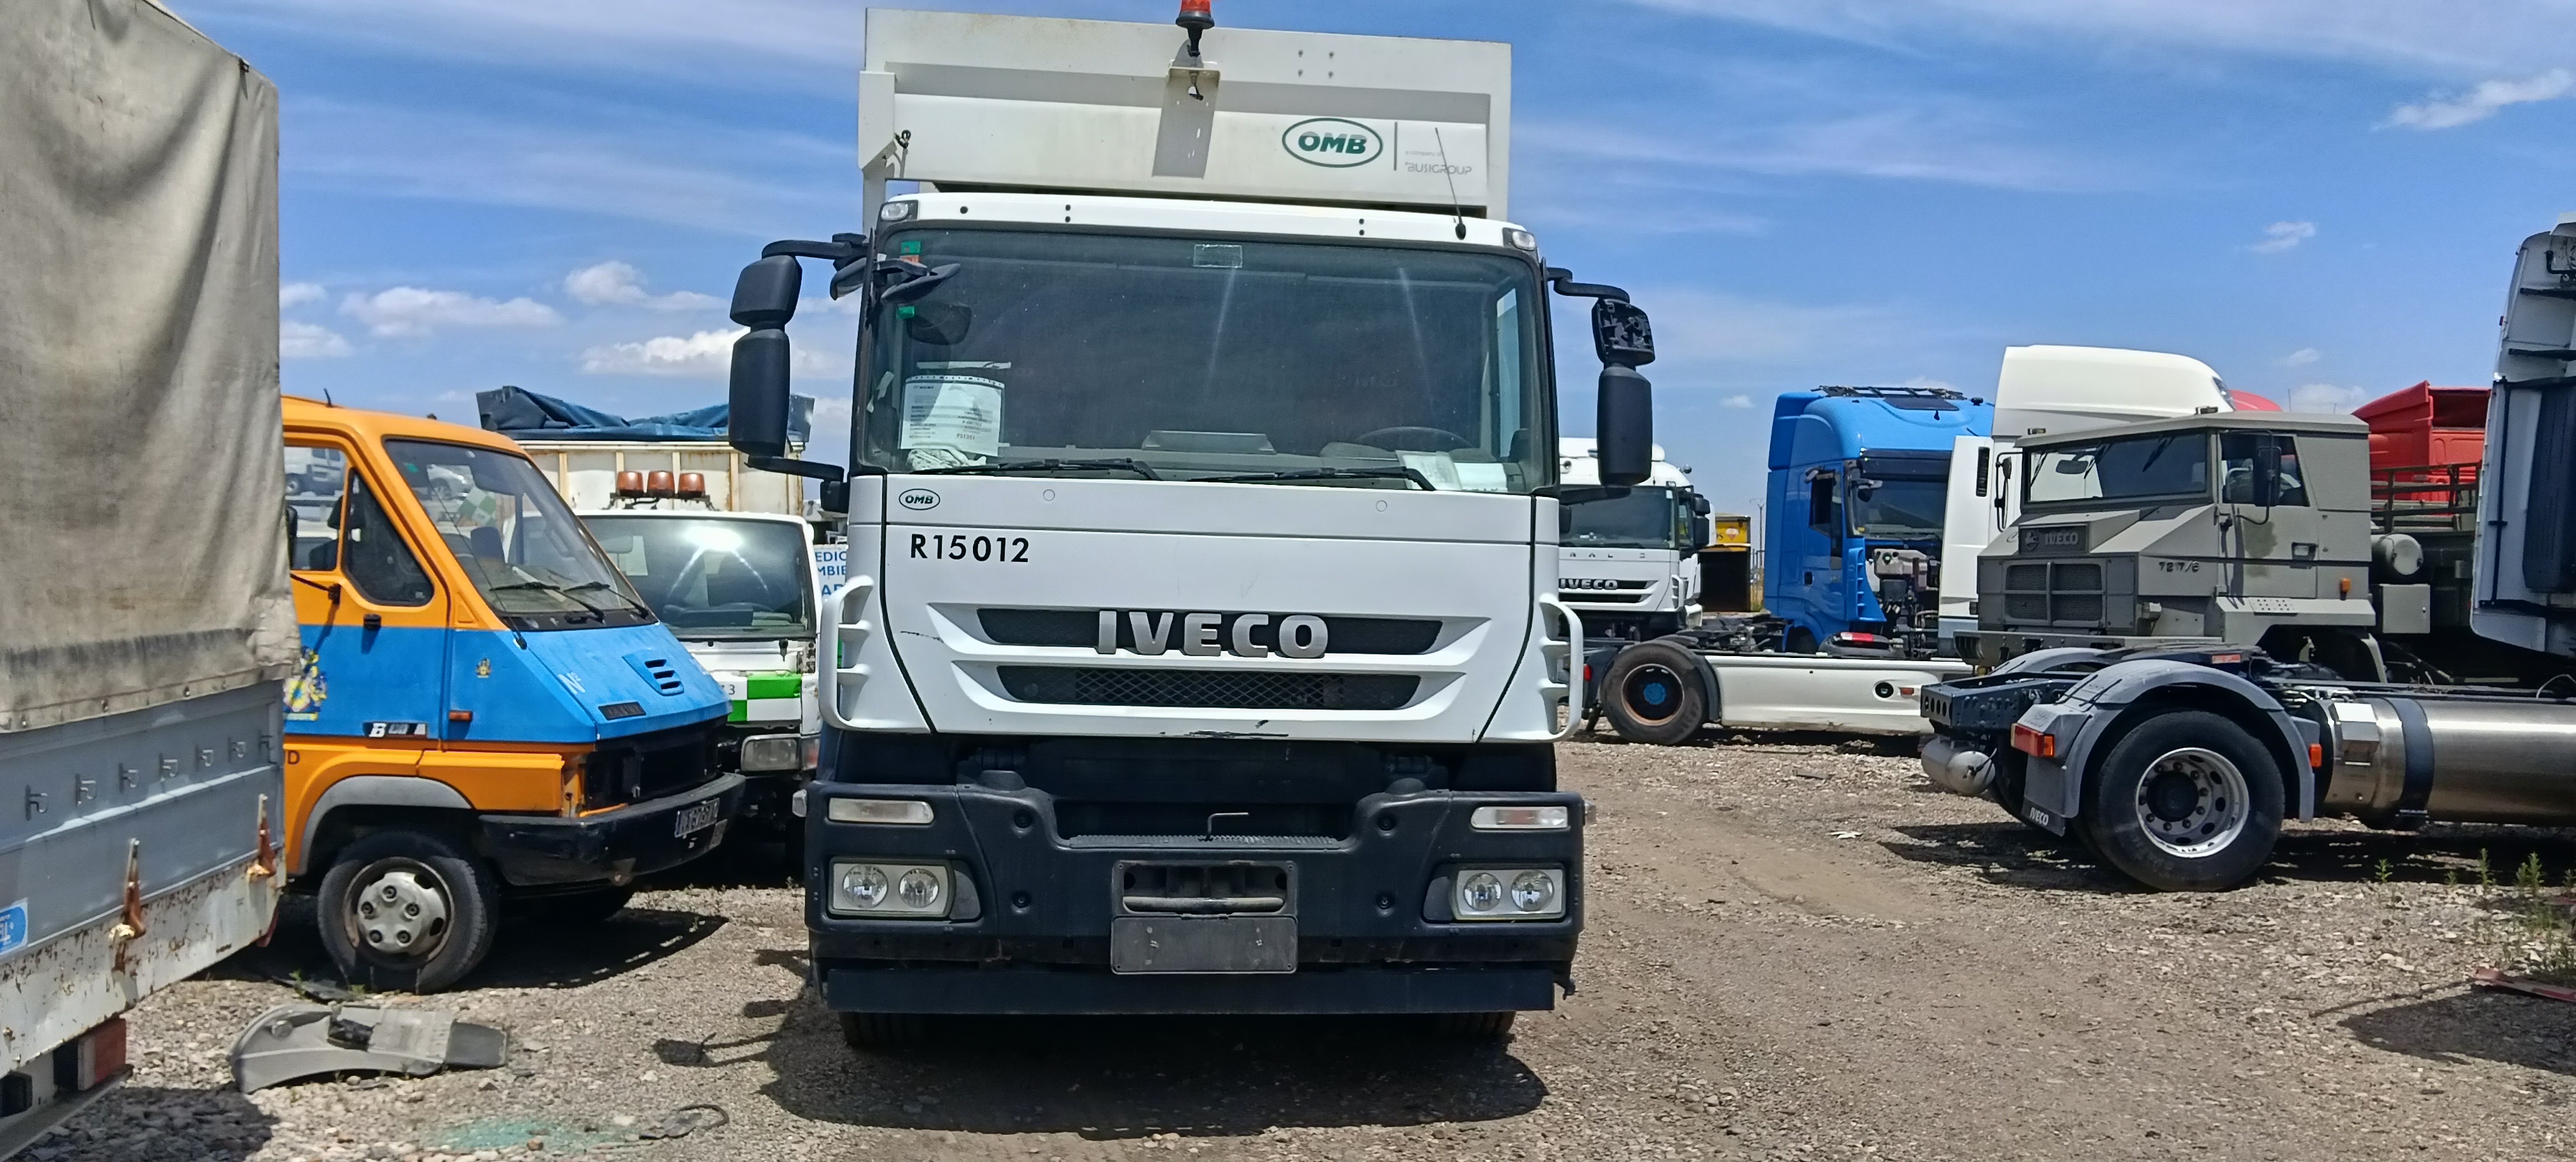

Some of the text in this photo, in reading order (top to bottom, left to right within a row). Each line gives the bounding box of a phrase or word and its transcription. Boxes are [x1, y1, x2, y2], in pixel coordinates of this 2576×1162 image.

[1298, 131, 1368, 155] OMB
[1405, 162, 1472, 175] BUSIGROUP
[905, 494, 934, 504] OMB
[2045, 532, 2079, 546] IVECO
[910, 534, 1029, 563] R15012
[1561, 578, 1618, 590] IVECO
[1097, 610, 1328, 659] IVECO
[2029, 806, 2049, 826] IVECO
